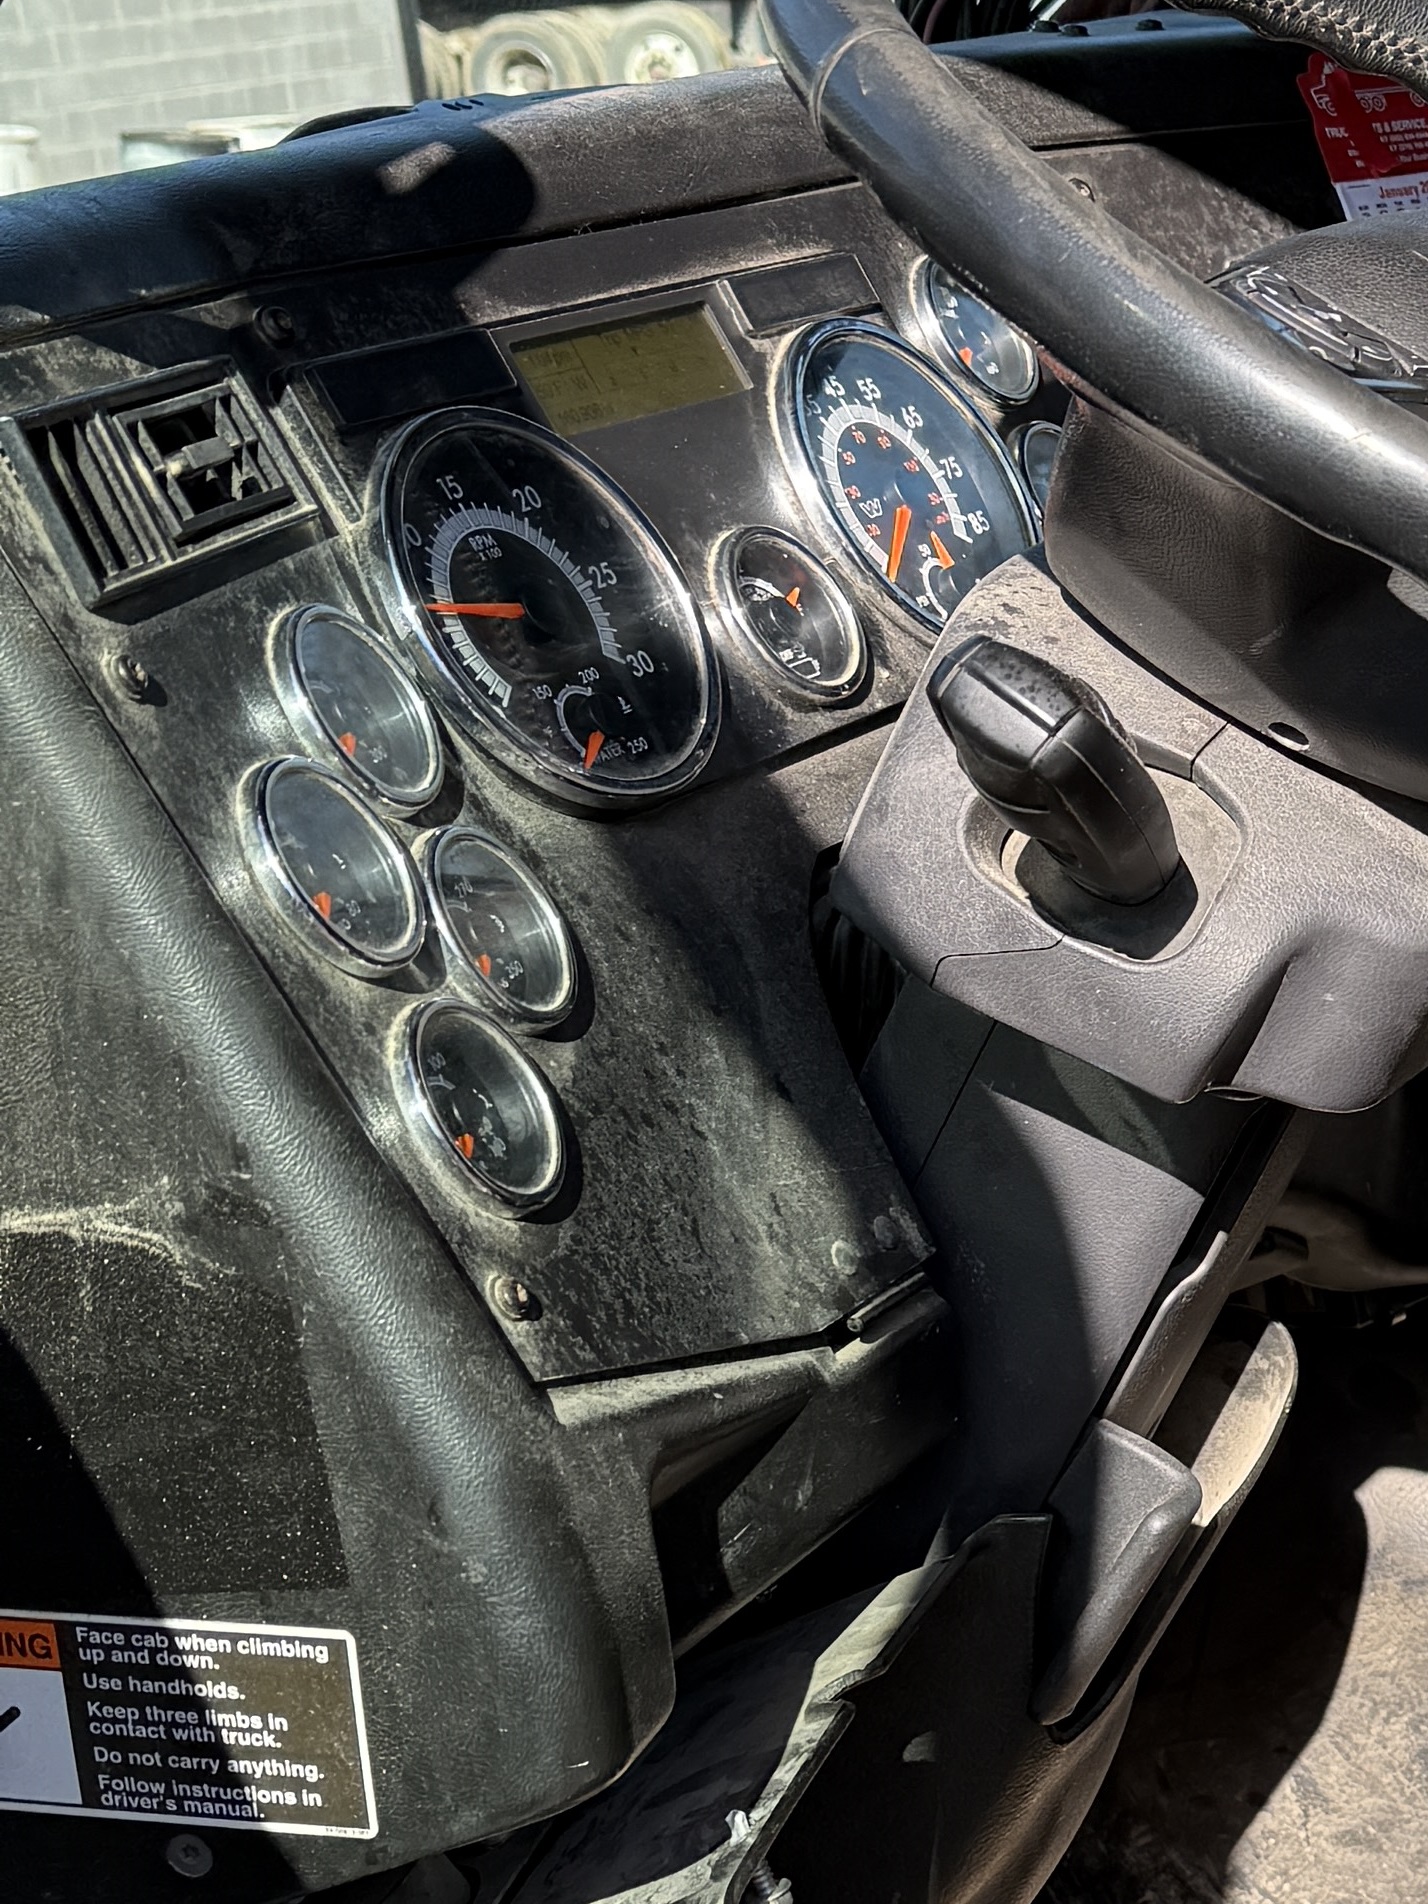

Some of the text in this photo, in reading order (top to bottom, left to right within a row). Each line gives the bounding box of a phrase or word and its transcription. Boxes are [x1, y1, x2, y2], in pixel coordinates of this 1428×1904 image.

[825, 376, 845, 396] 45
[856, 378, 881, 401] 55
[901, 406, 923, 429] 65
[939, 457, 963, 479] 75
[436, 475, 463, 500] 15
[512, 485, 542, 512] 20
[967, 510, 990, 534] 85
[468, 533, 497, 550] RPM
[588, 562, 617, 589] 25
[578, 666, 600, 684] 200
[625, 650, 655, 678] 30
[627, 737, 649, 755] 250
[75, 1626, 329, 1664] Face cab when climbing
[79, 1647, 220, 1670] up and down.
[83, 1672, 246, 1700] Use handholds.
[87, 1701, 289, 1732] Keep three limbs in
[89, 1722, 282, 1748] contact with truck.
[93, 1746, 325, 1783] Do not carry anything.
[98, 1774, 323, 1807] Follow instructions in
[100, 1792, 265, 1818] driver's manual.
